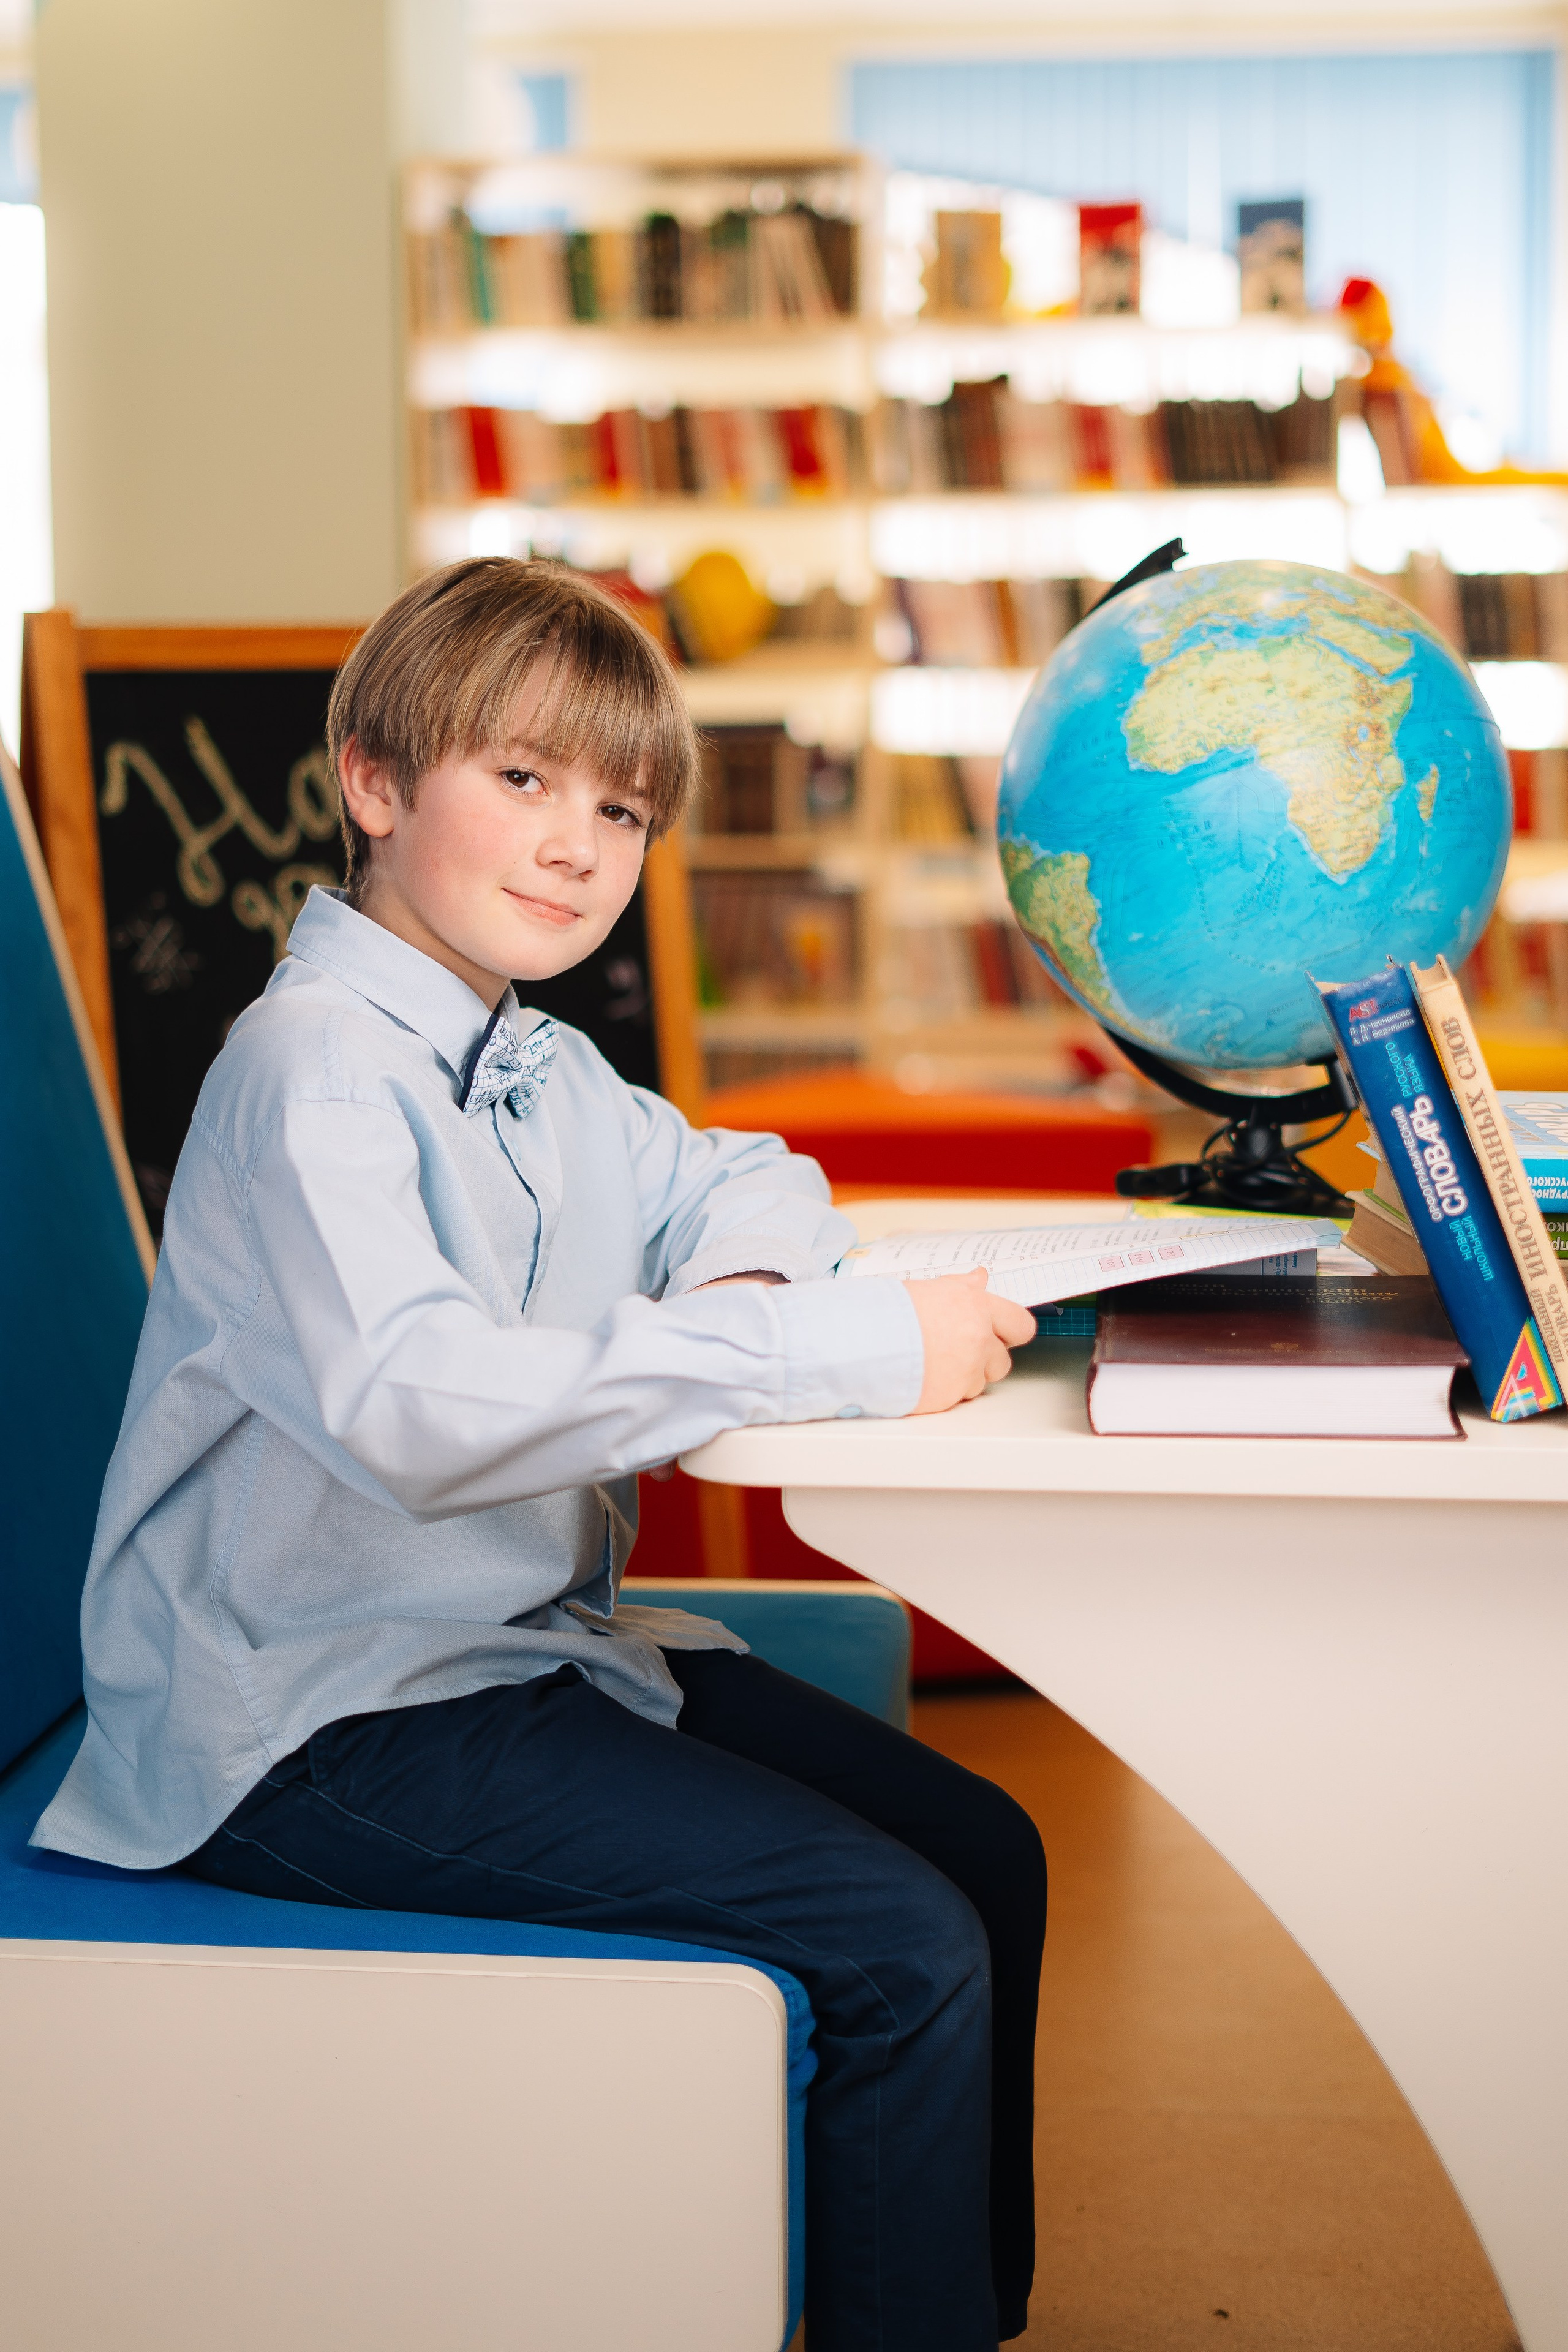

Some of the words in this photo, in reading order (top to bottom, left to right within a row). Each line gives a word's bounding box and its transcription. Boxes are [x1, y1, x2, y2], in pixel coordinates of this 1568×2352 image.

[1349, 1027, 1359, 1036] Л.
[1353, 1037, 1361, 1046] А.
[1362, 1033, 1371, 1042] Н.
[1441, 1017, 1476, 1080] СЛОВ
[1385, 1042, 1413, 1098] РУССКОГО
[1403, 1053, 1425, 1093] ЯЗЫКА
[1390, 1105, 1442, 1221] ОРФОГРАФИЧЕСКИЙ
[1409, 1097, 1466, 1215] СЛОВАРЬ
[1465, 1087, 1548, 1281] ИНОСТРАННЫХ
[1449, 1219, 1473, 1261] НОВЫЙ
[1461, 1216, 1494, 1281] ШКОЛЬНЫЙ
[1528, 1287, 1565, 1365] ШКОЛЬНЫЙ
